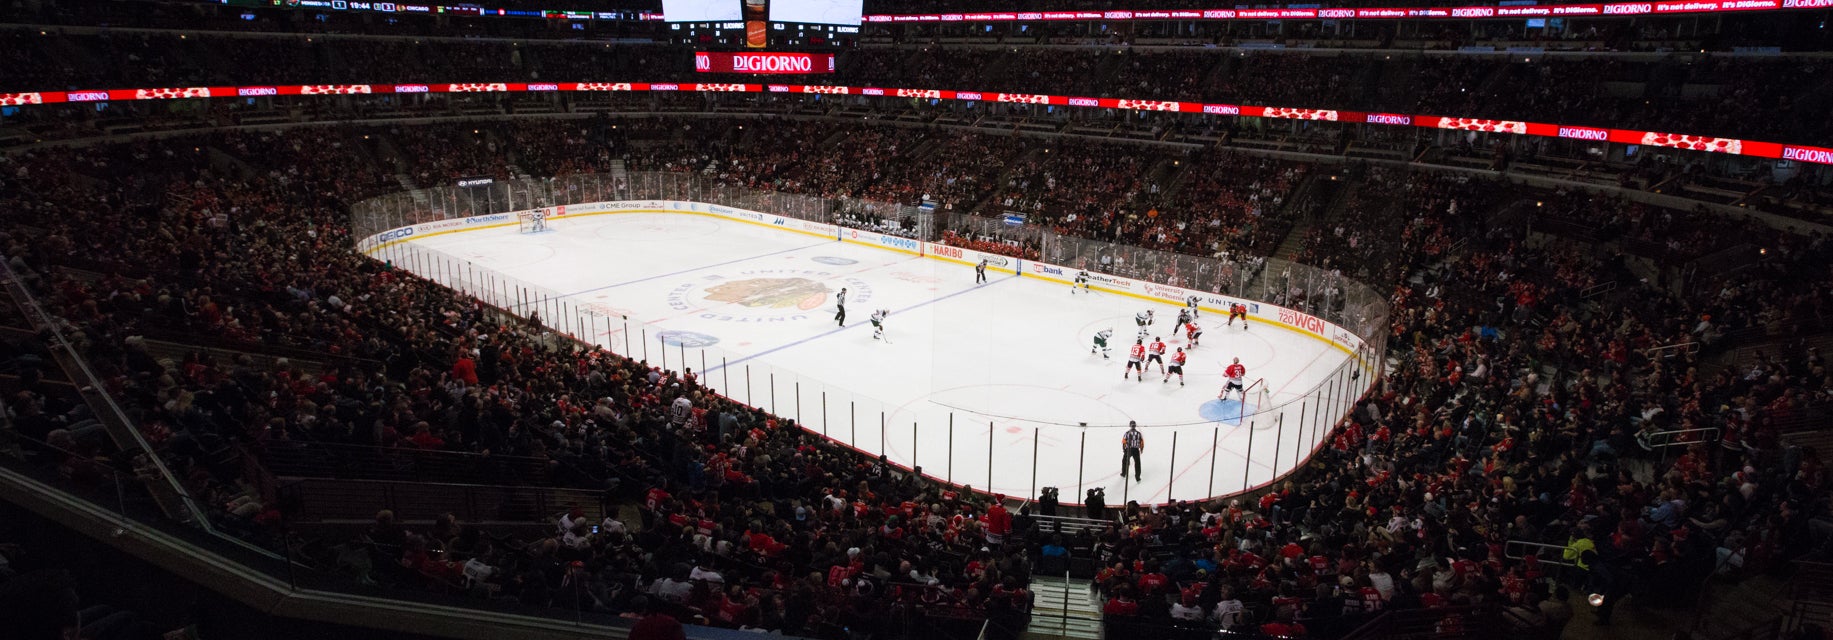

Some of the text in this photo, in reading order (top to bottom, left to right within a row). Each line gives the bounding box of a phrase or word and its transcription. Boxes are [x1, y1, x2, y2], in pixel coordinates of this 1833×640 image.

[1318, 10, 1354, 18] DIGIORNO
[1452, 9, 1493, 17] DIGIORNO
[1603, 4, 1652, 14] DIGIORNO
[733, 56, 812, 71] DIGIORNO
[68, 92, 109, 102] DIGIORNO
[238, 88, 277, 96] DIGIORNO
[1068, 98, 1098, 107] DIGIORNO
[1203, 106, 1239, 115] DIGIORNO
[1367, 115, 1410, 125] DIGIORNO
[1559, 128, 1606, 140] DIGIORNO
[468, 179, 493, 188] HYUNDAI
[379, 227, 413, 242] GEICO
[933, 246, 963, 259] HARIBO
[1086, 275, 1130, 288] eatherTech
[1154, 285, 1185, 296] University
[1162, 292, 1185, 302] Phoenix
[1279, 312, 1326, 335] 720 WGN
